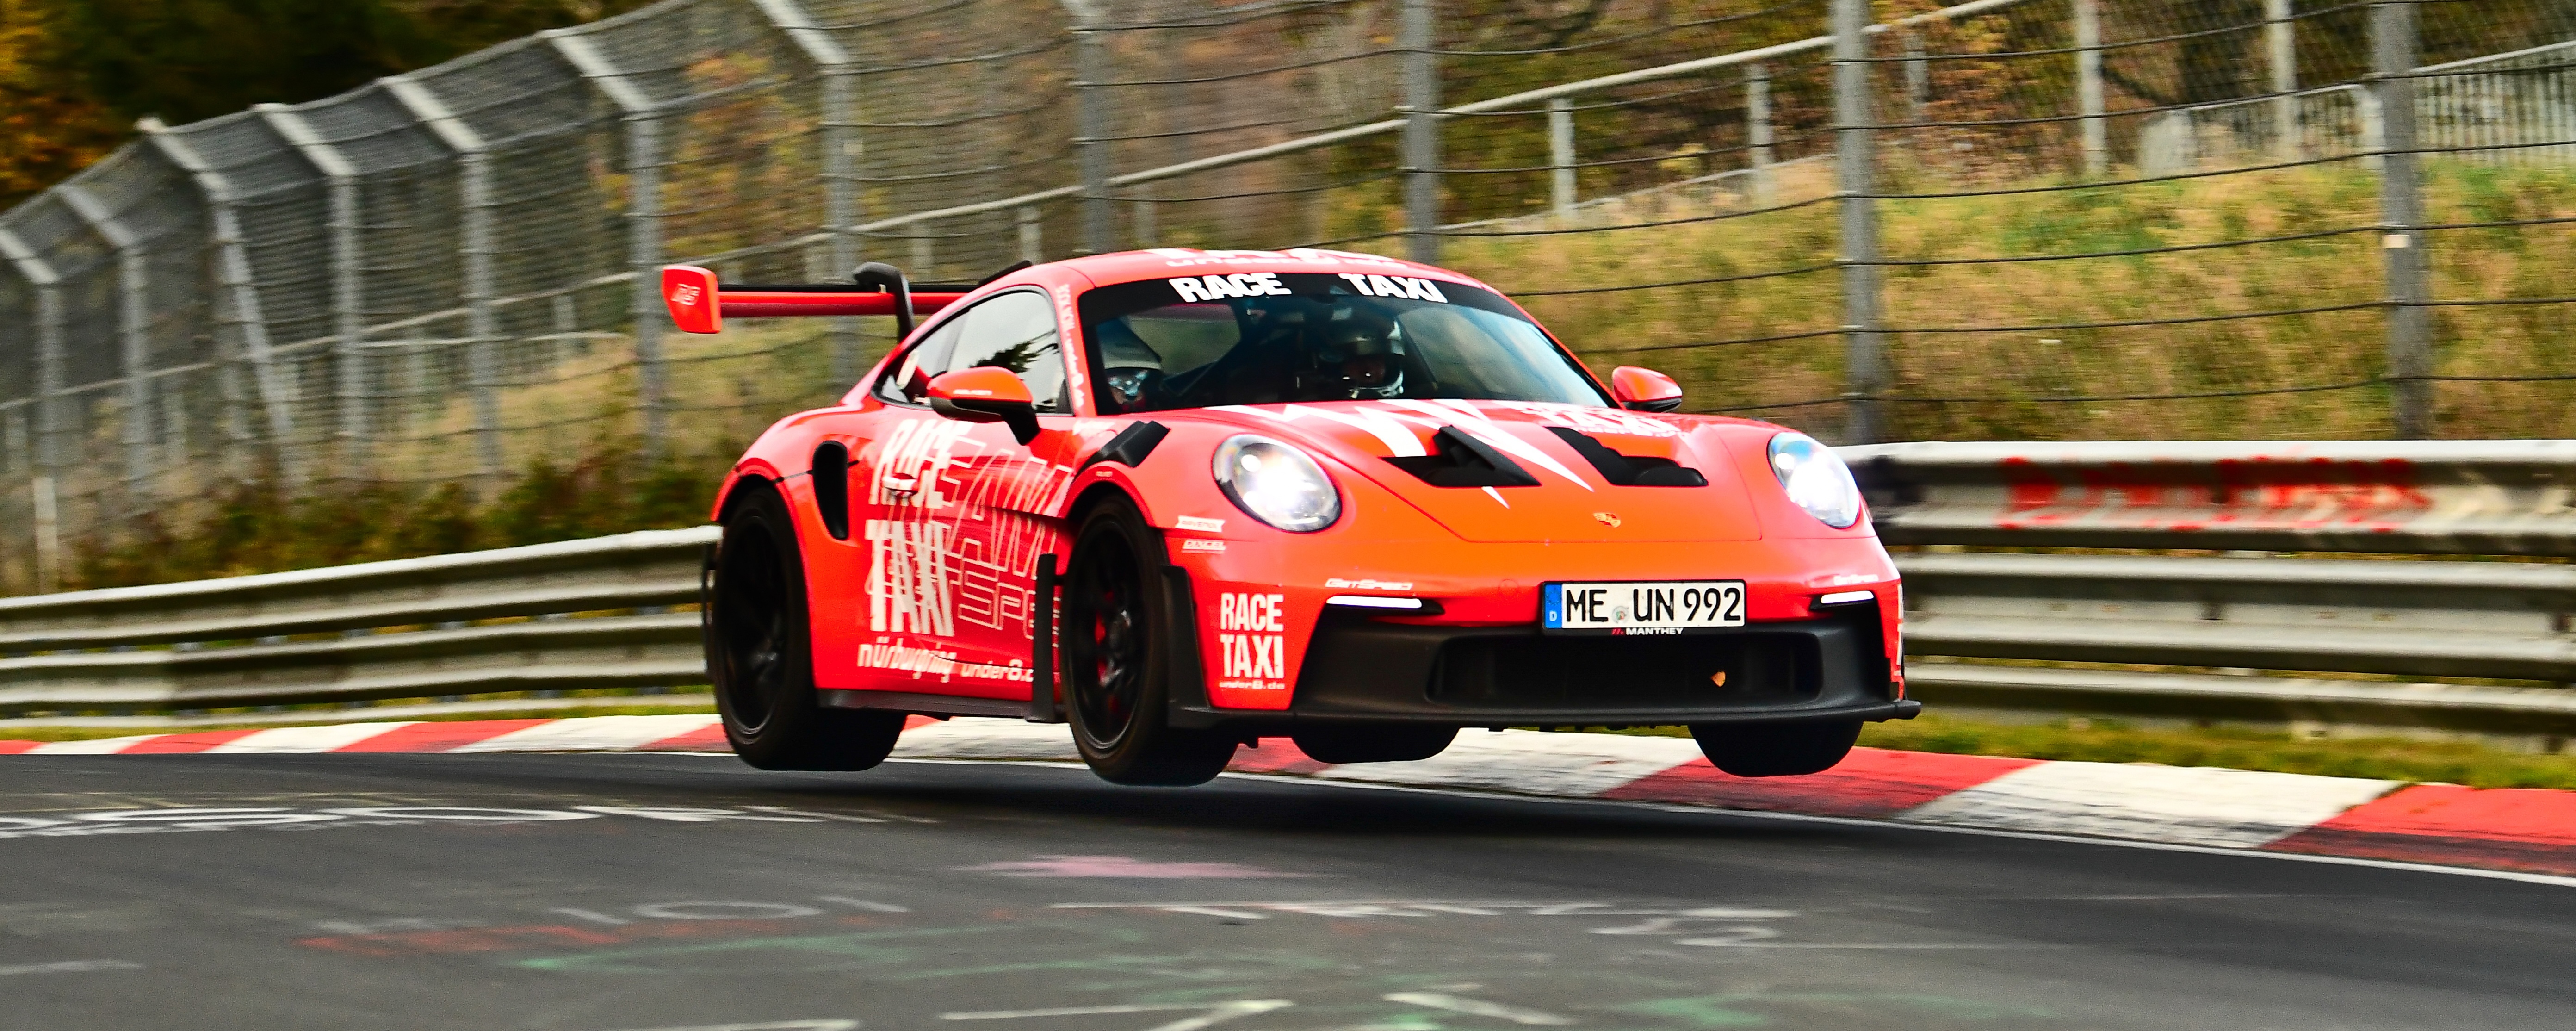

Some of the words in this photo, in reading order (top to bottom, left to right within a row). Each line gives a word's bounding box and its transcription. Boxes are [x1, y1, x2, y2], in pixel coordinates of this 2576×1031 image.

[1169, 273, 1292, 303] RACE
[1338, 273, 1448, 303] TAXI
[868, 419, 974, 509] RACE
[865, 519, 955, 637] TAXI
[1220, 592, 1284, 632] RACE
[1549, 610, 1558, 621] D
[1567, 589, 1608, 622] ME
[1633, 589, 1674, 621] UN
[1684, 587, 1741, 621] 992
[1626, 627, 1684, 635] MANTHEY
[1220, 634, 1284, 679] TAXI
